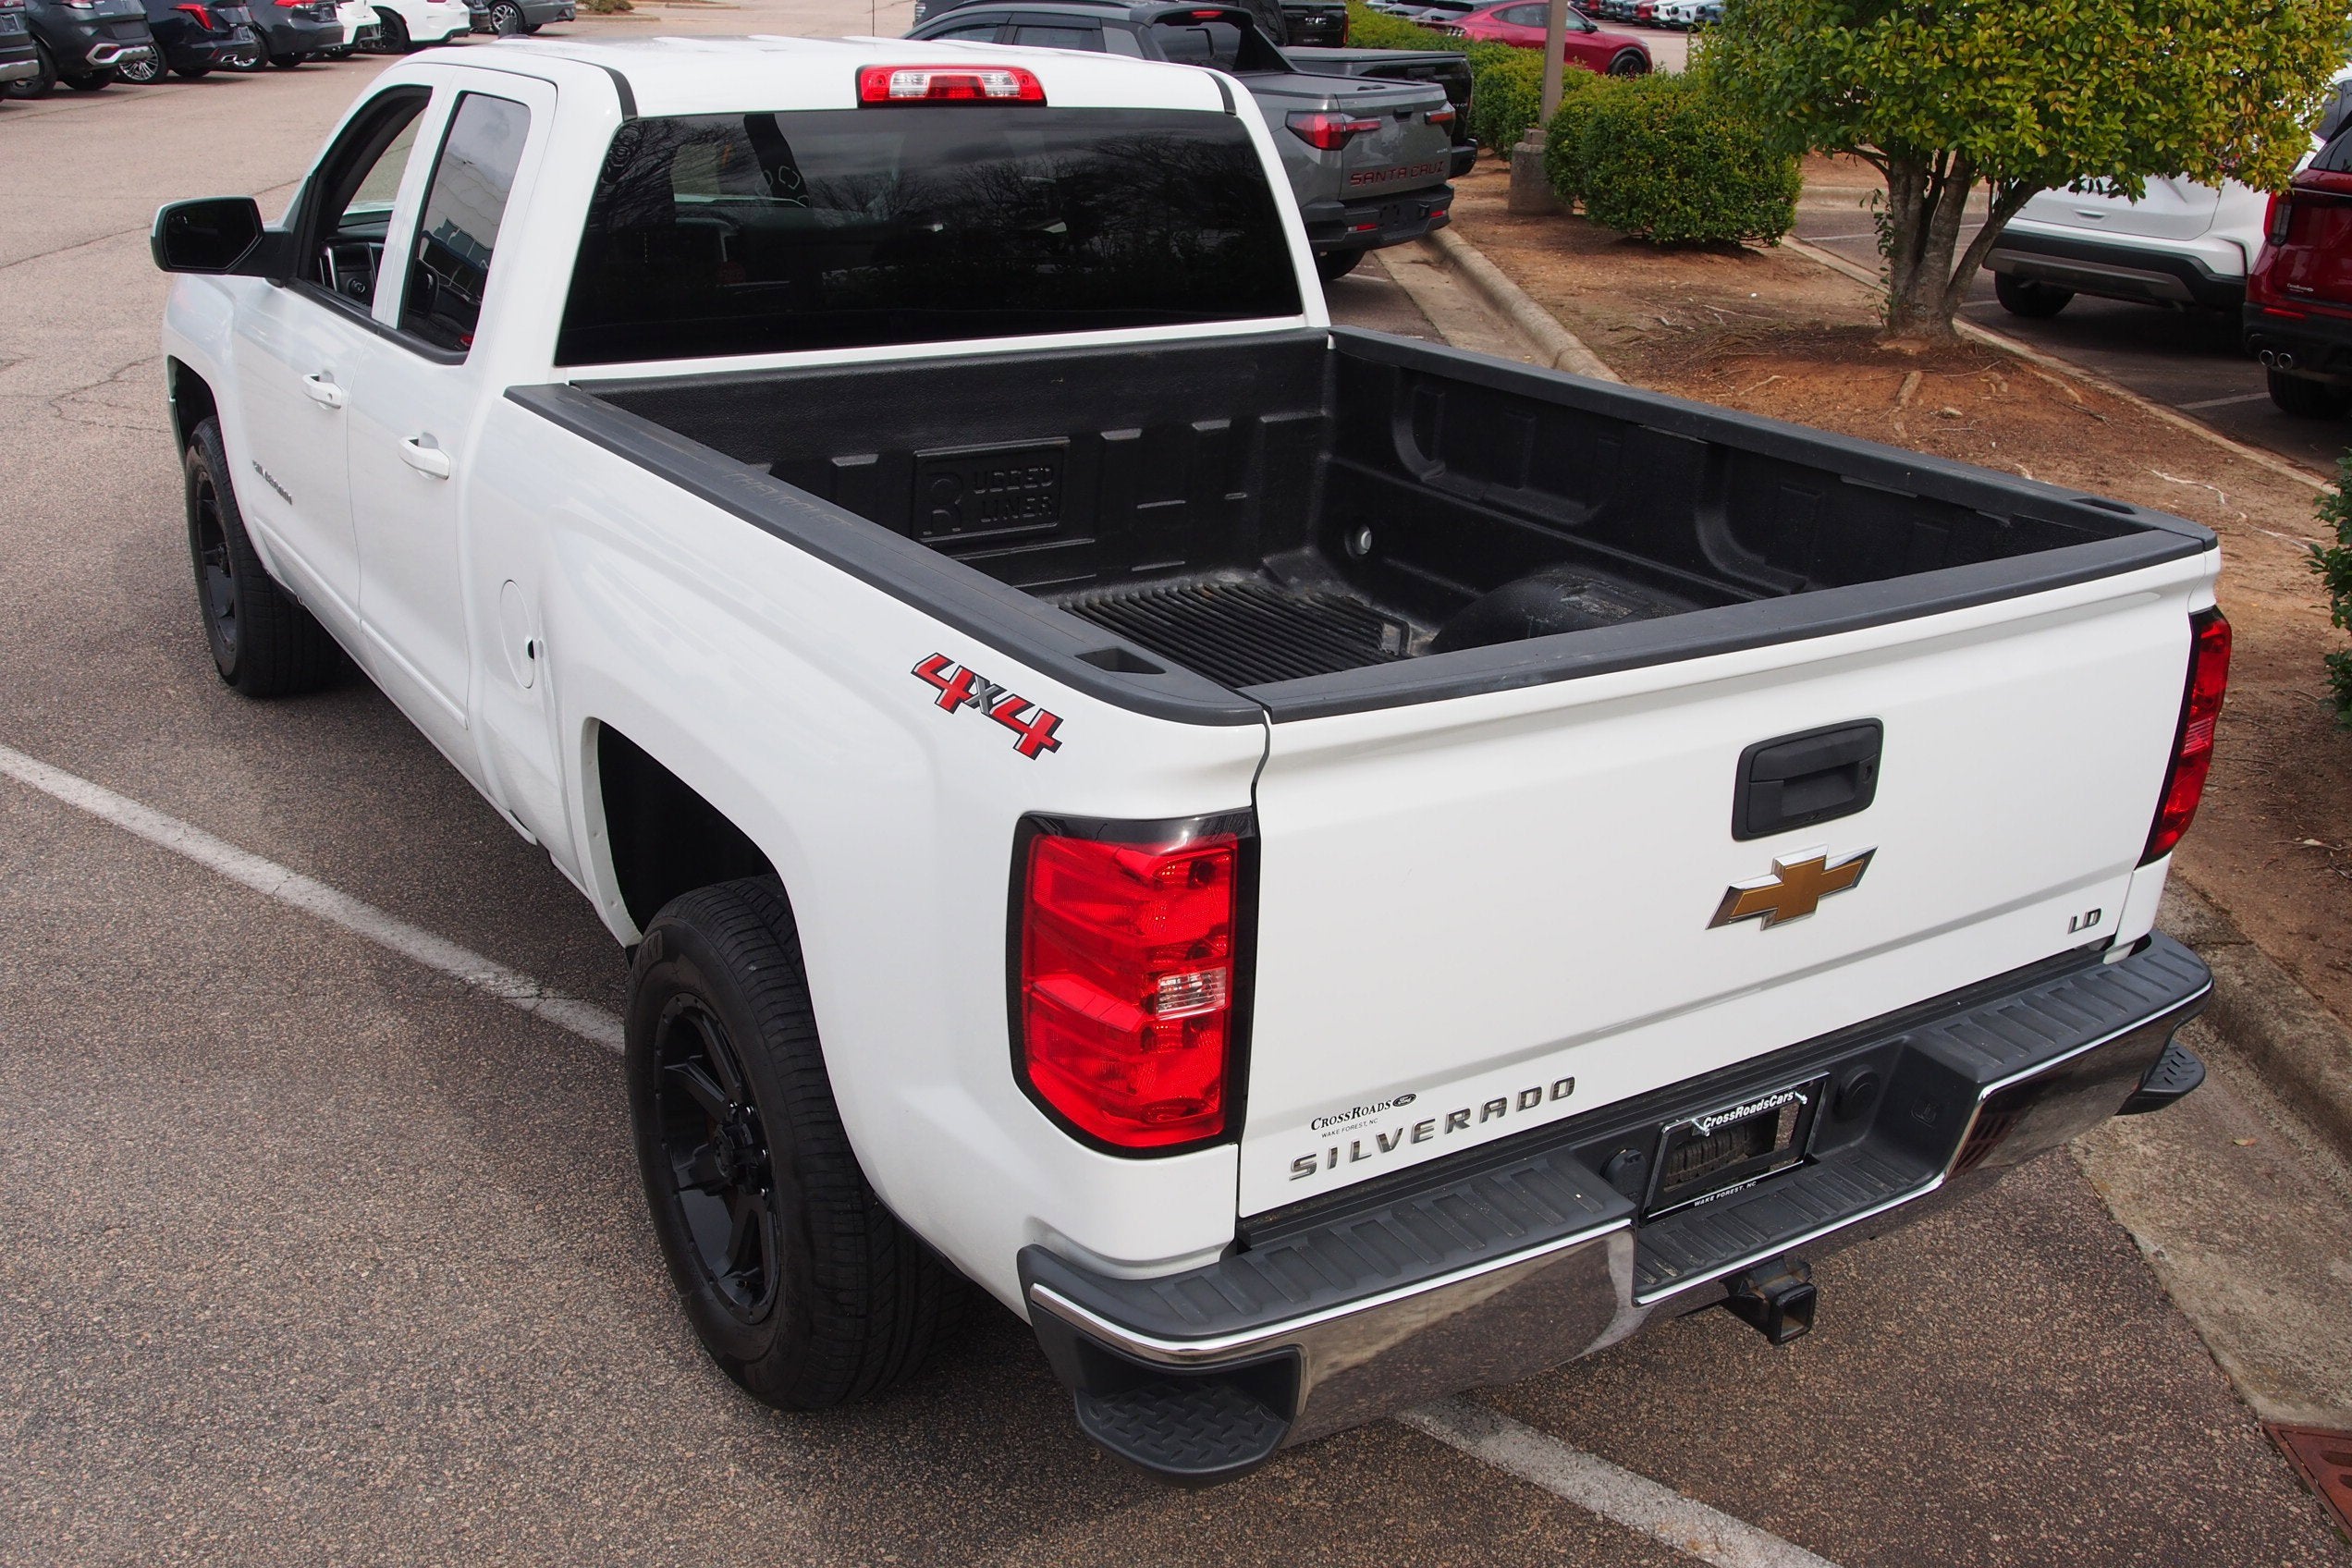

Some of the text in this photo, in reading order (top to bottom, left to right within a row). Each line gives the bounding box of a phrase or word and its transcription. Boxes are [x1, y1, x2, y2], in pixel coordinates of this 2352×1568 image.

[1350, 161, 1445, 185] SANTA CRUZ
[2067, 907, 2102, 935] LD
[1703, 1089, 1795, 1130] CrossRoadsCars
[1289, 1075, 1575, 1182] SILVERADO
[1321, 1128, 1340, 1138] WAKE
[1694, 1195, 1715, 1207] WAKE
[1746, 1181, 1757, 1189] NC
